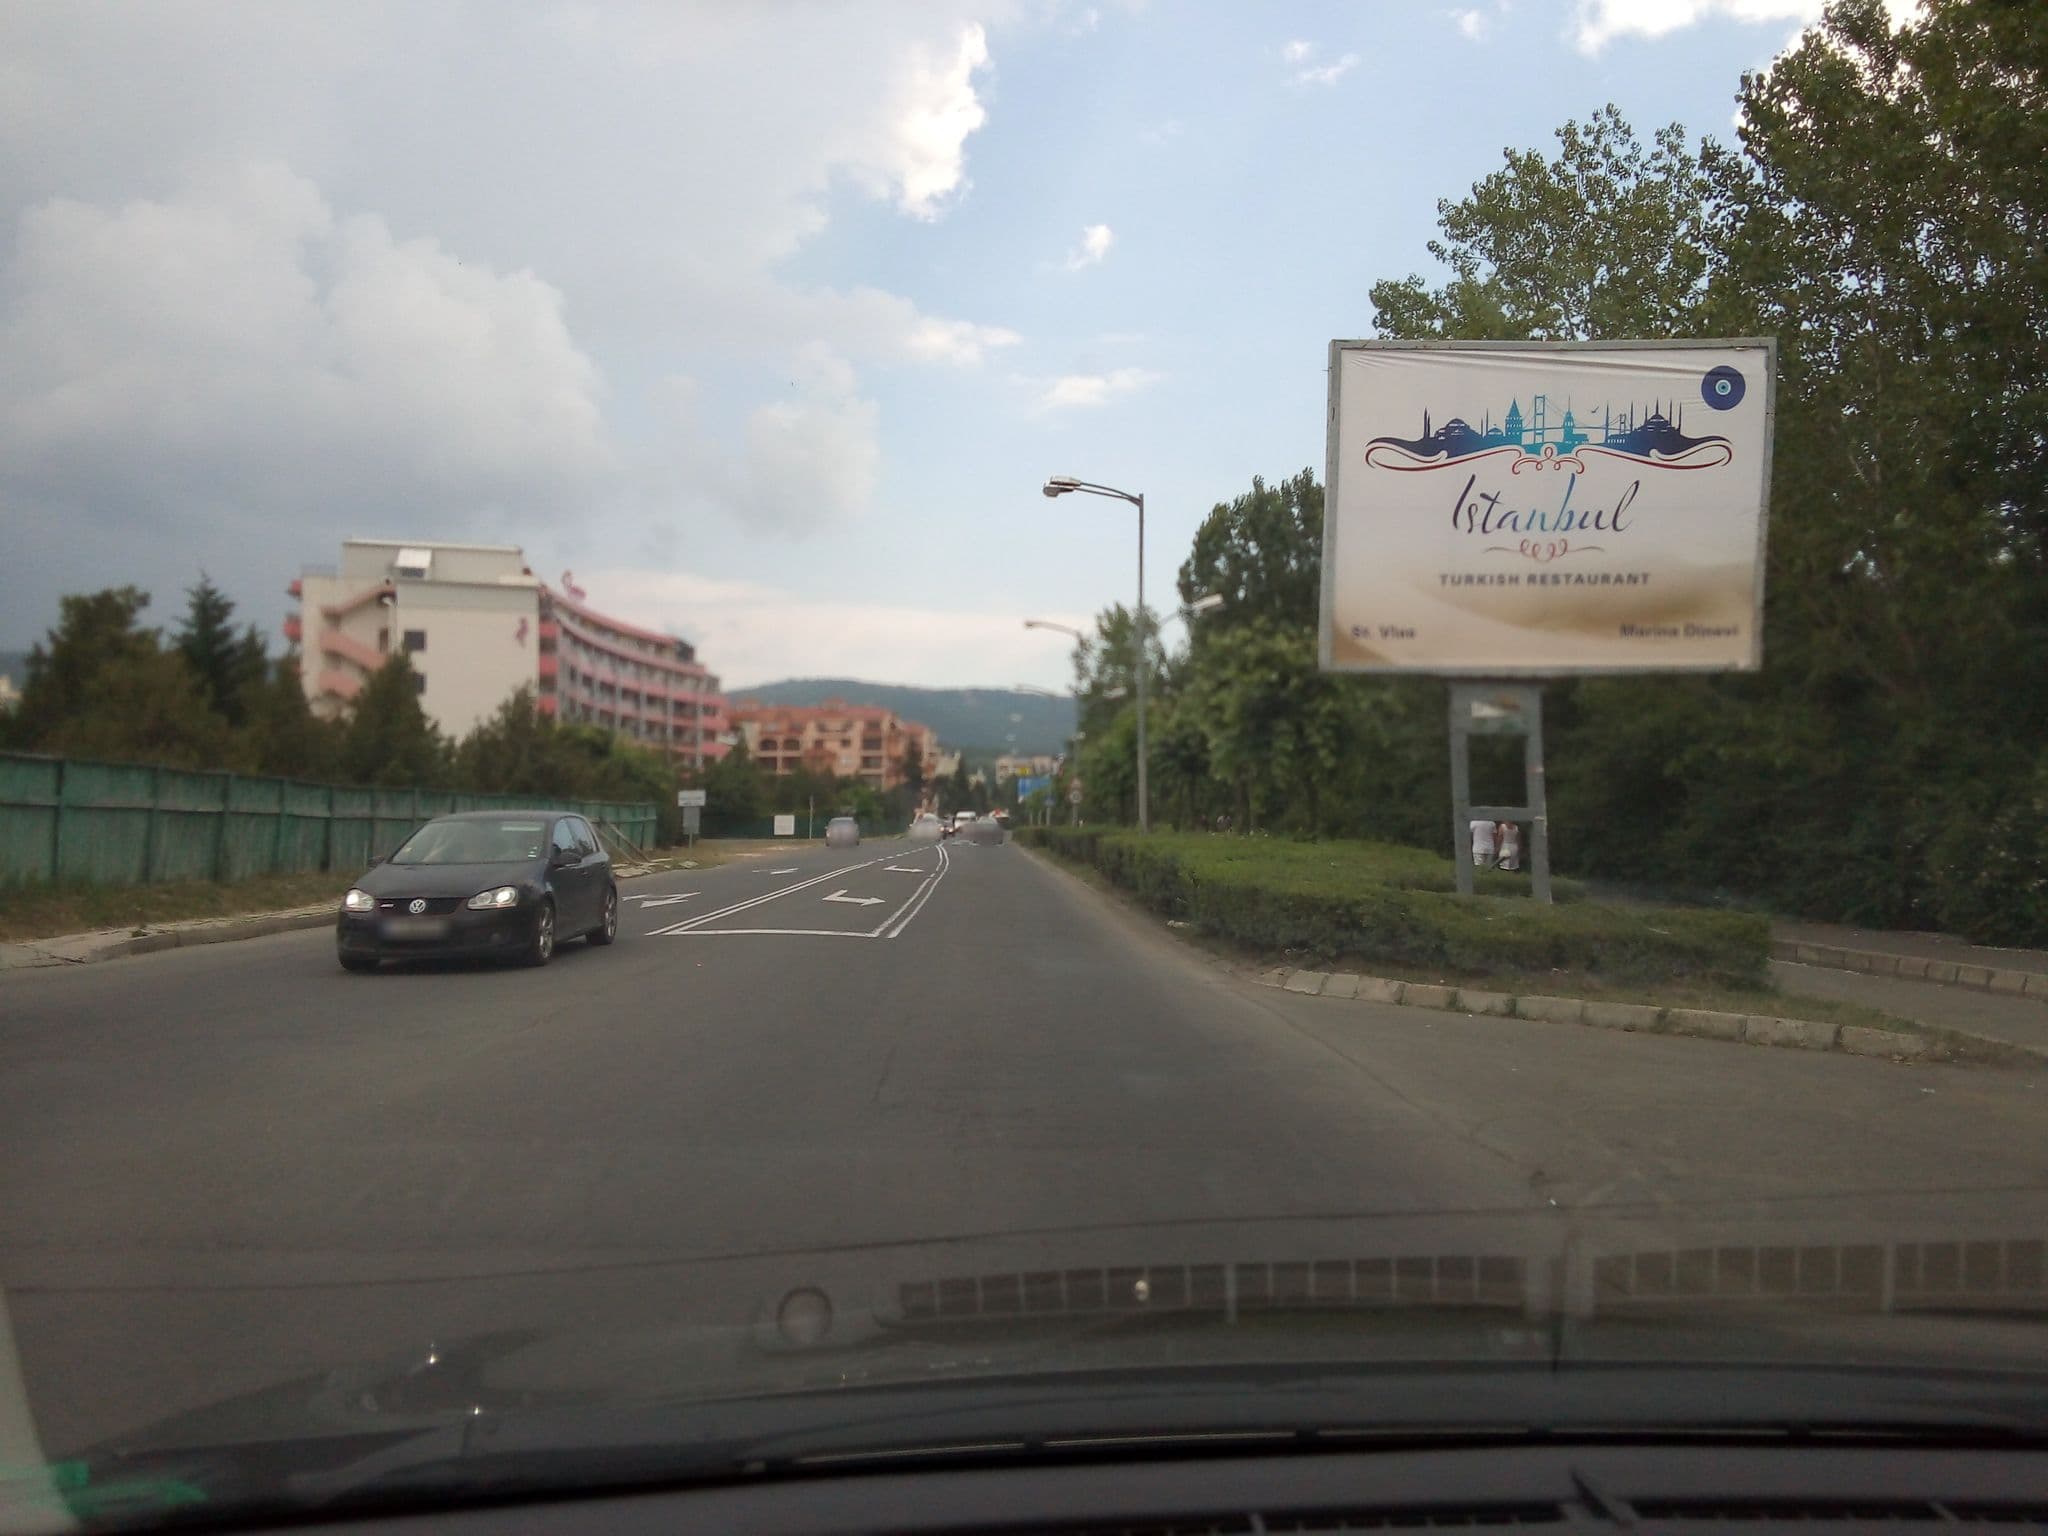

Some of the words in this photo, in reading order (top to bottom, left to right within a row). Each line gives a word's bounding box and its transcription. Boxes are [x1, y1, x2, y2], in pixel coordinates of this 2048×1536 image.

[1453, 473, 1640, 534] Istanbul
[1440, 573, 1520, 586] TURKISH
[1526, 572, 1650, 585] RESTAURANT
